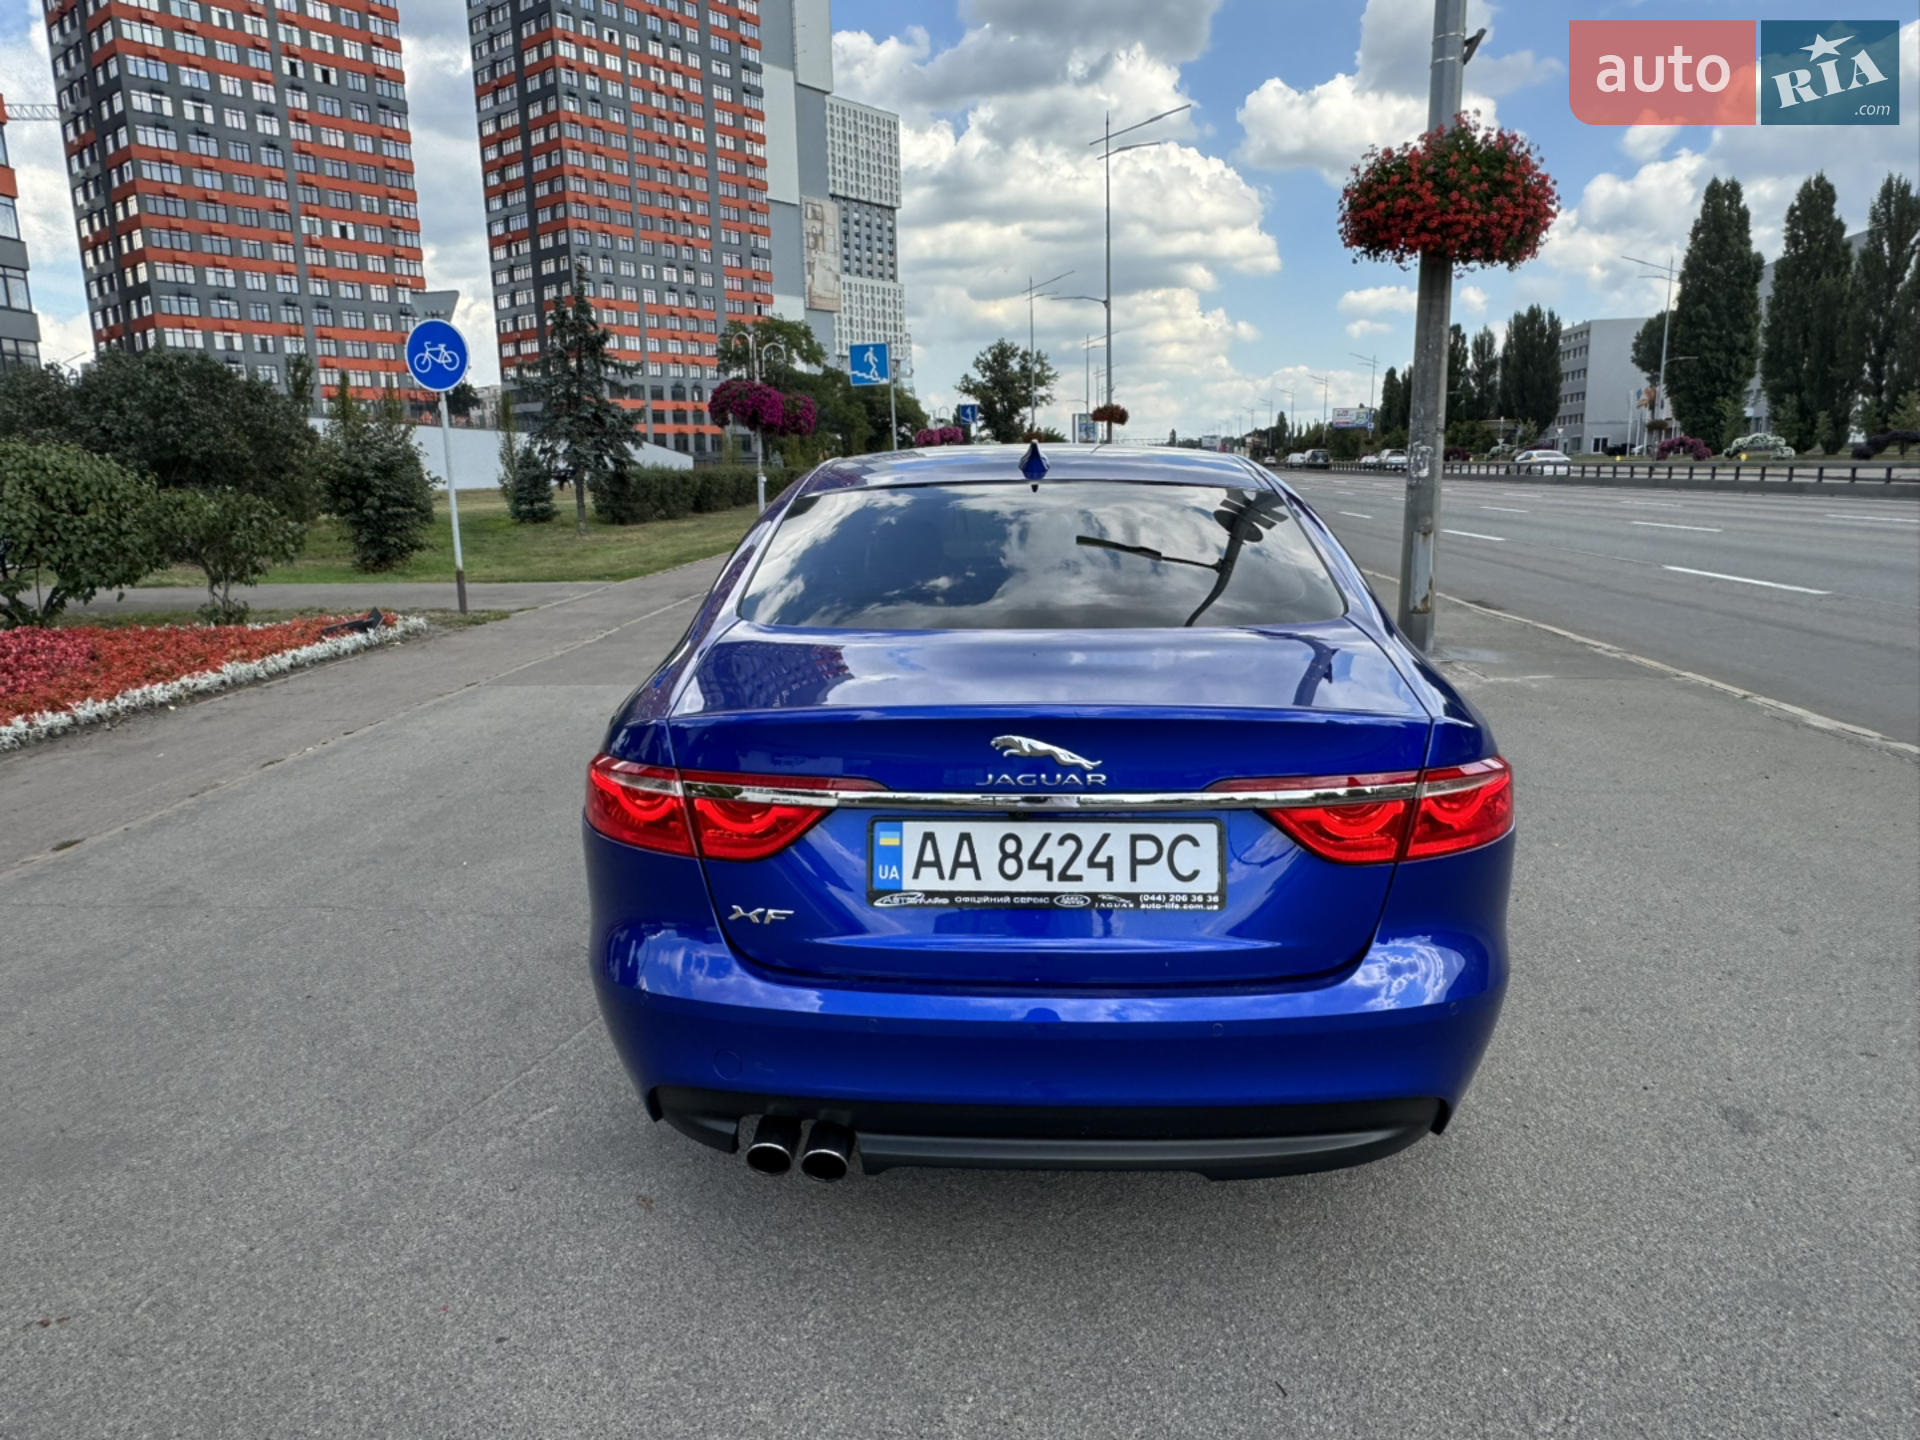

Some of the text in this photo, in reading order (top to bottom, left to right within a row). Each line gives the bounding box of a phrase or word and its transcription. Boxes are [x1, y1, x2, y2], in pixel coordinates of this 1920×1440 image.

[975, 773, 1107, 786] JAGUAR
[911, 831, 1201, 883] AA 8424 PC
[878, 864, 900, 880] UA
[1139, 894, 1166, 904] (044)
[1140, 902, 1220, 911] auto-life.com.ua
[727, 904, 795, 925] XF
